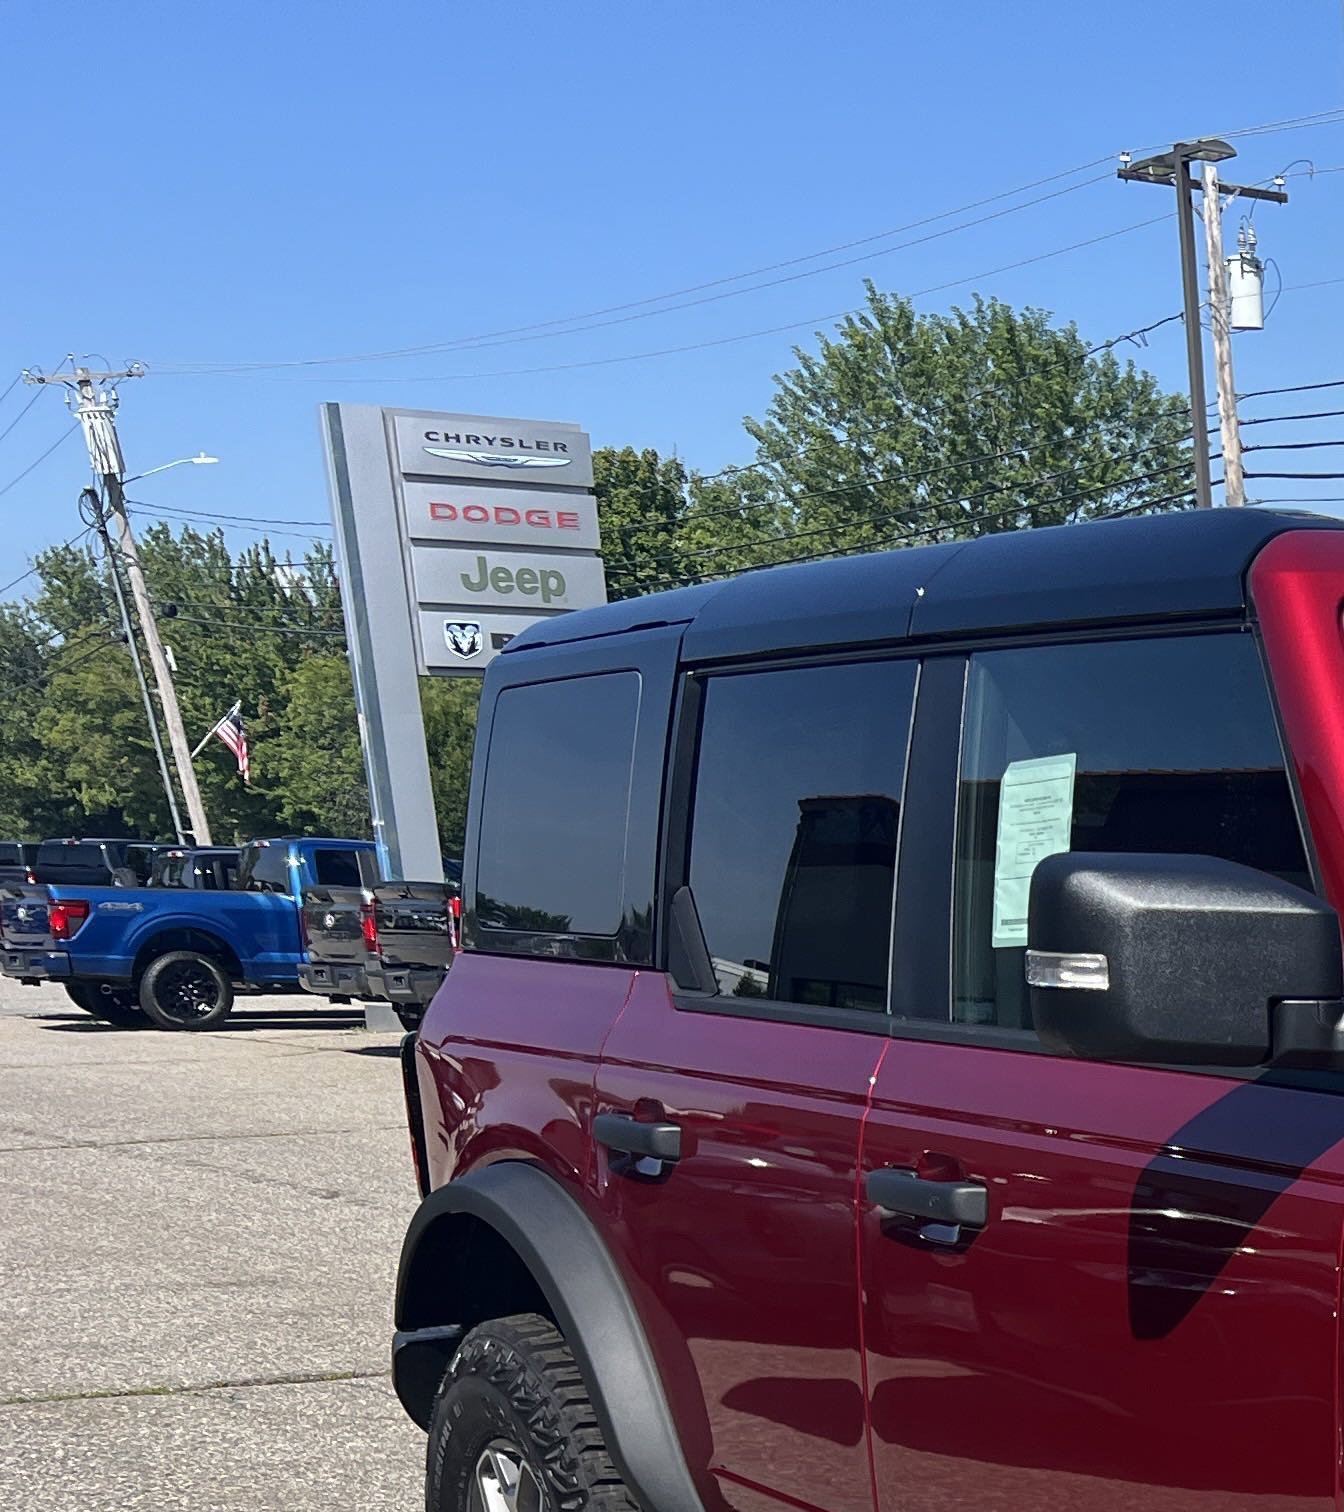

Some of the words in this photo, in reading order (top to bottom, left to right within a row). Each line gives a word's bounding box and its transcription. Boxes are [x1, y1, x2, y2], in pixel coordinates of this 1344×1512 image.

[424, 430, 569, 453] CHRYSLER
[429, 502, 581, 531] DODGE
[460, 556, 566, 603] Jeep
